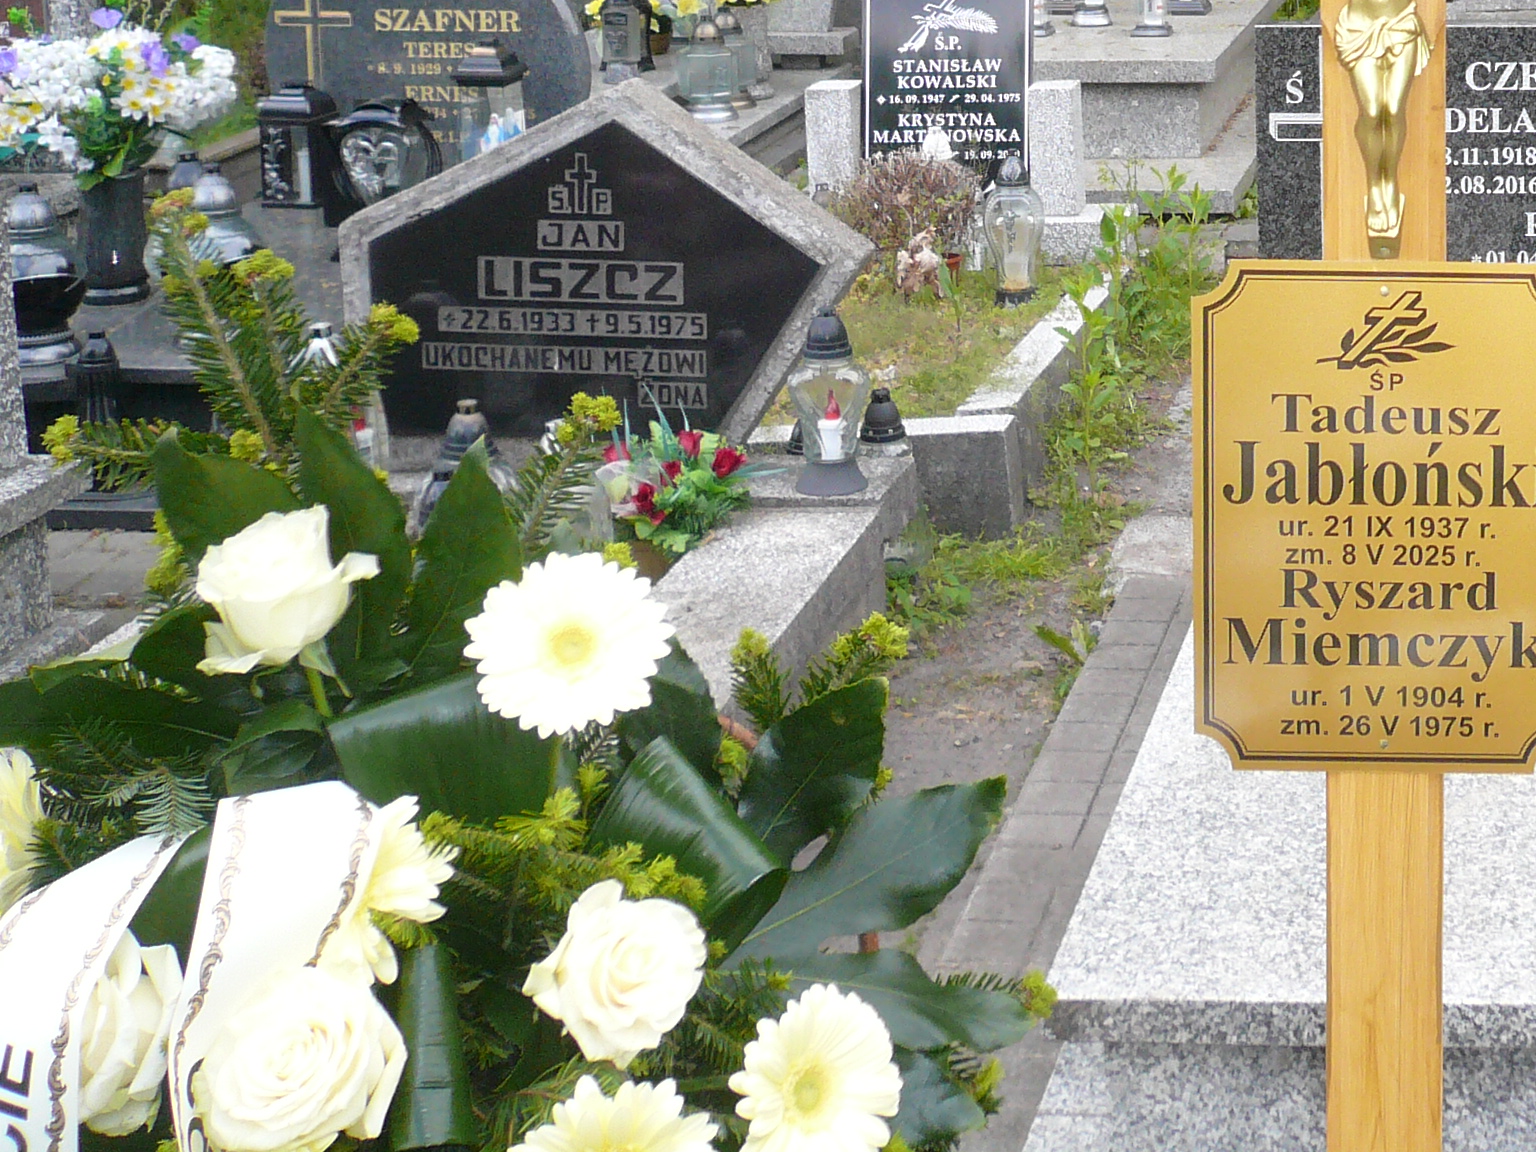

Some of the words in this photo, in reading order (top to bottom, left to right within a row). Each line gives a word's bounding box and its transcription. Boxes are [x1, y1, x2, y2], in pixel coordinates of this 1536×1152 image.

[374, 8, 522, 33] SZAFNER
[403, 41, 479, 59] TERES
[893, 58, 1002, 74] STANISŁAW
[897, 74, 997, 90] KOWALSKI
[898, 112, 997, 128] KRYSTYNA
[873, 128, 1021, 144] MARTNOWSKA
[541, 223, 621, 248] JAN
[484, 259, 678, 301] LISZCZ
[425, 344, 592, 371] UKOCHANEMU
[640, 380, 705, 406] ŻONA
[1271, 393, 1502, 437] Tadeusz
[1278, 520, 1314, 538] ur.
[1324, 517, 1354, 538] 21
[1366, 517, 1394, 538] IX
[1404, 518, 1469, 539] 1937
[1480, 522, 1497, 539] r.
[1285, 550, 1332, 566] zm.
[1342, 544, 1355, 566] 8
[1366, 545, 1386, 566] V
[1392, 545, 1456, 567] 2025
[1465, 550, 1481, 567] r.
[1278, 568, 1499, 621] Ryszard
[1291, 690, 1328, 707] ur.
[1340, 686, 1352, 707] 1
[1366, 686, 1386, 707] V
[1396, 686, 1465, 708] 1904
[1475, 691, 1492, 709] r.
[1280, 720, 1329, 736] zm.
[1339, 715, 1371, 736] 26
[1381, 715, 1400, 736] V
[1408, 715, 1474, 737] 1975
[1483, 721, 1500, 738] r.
